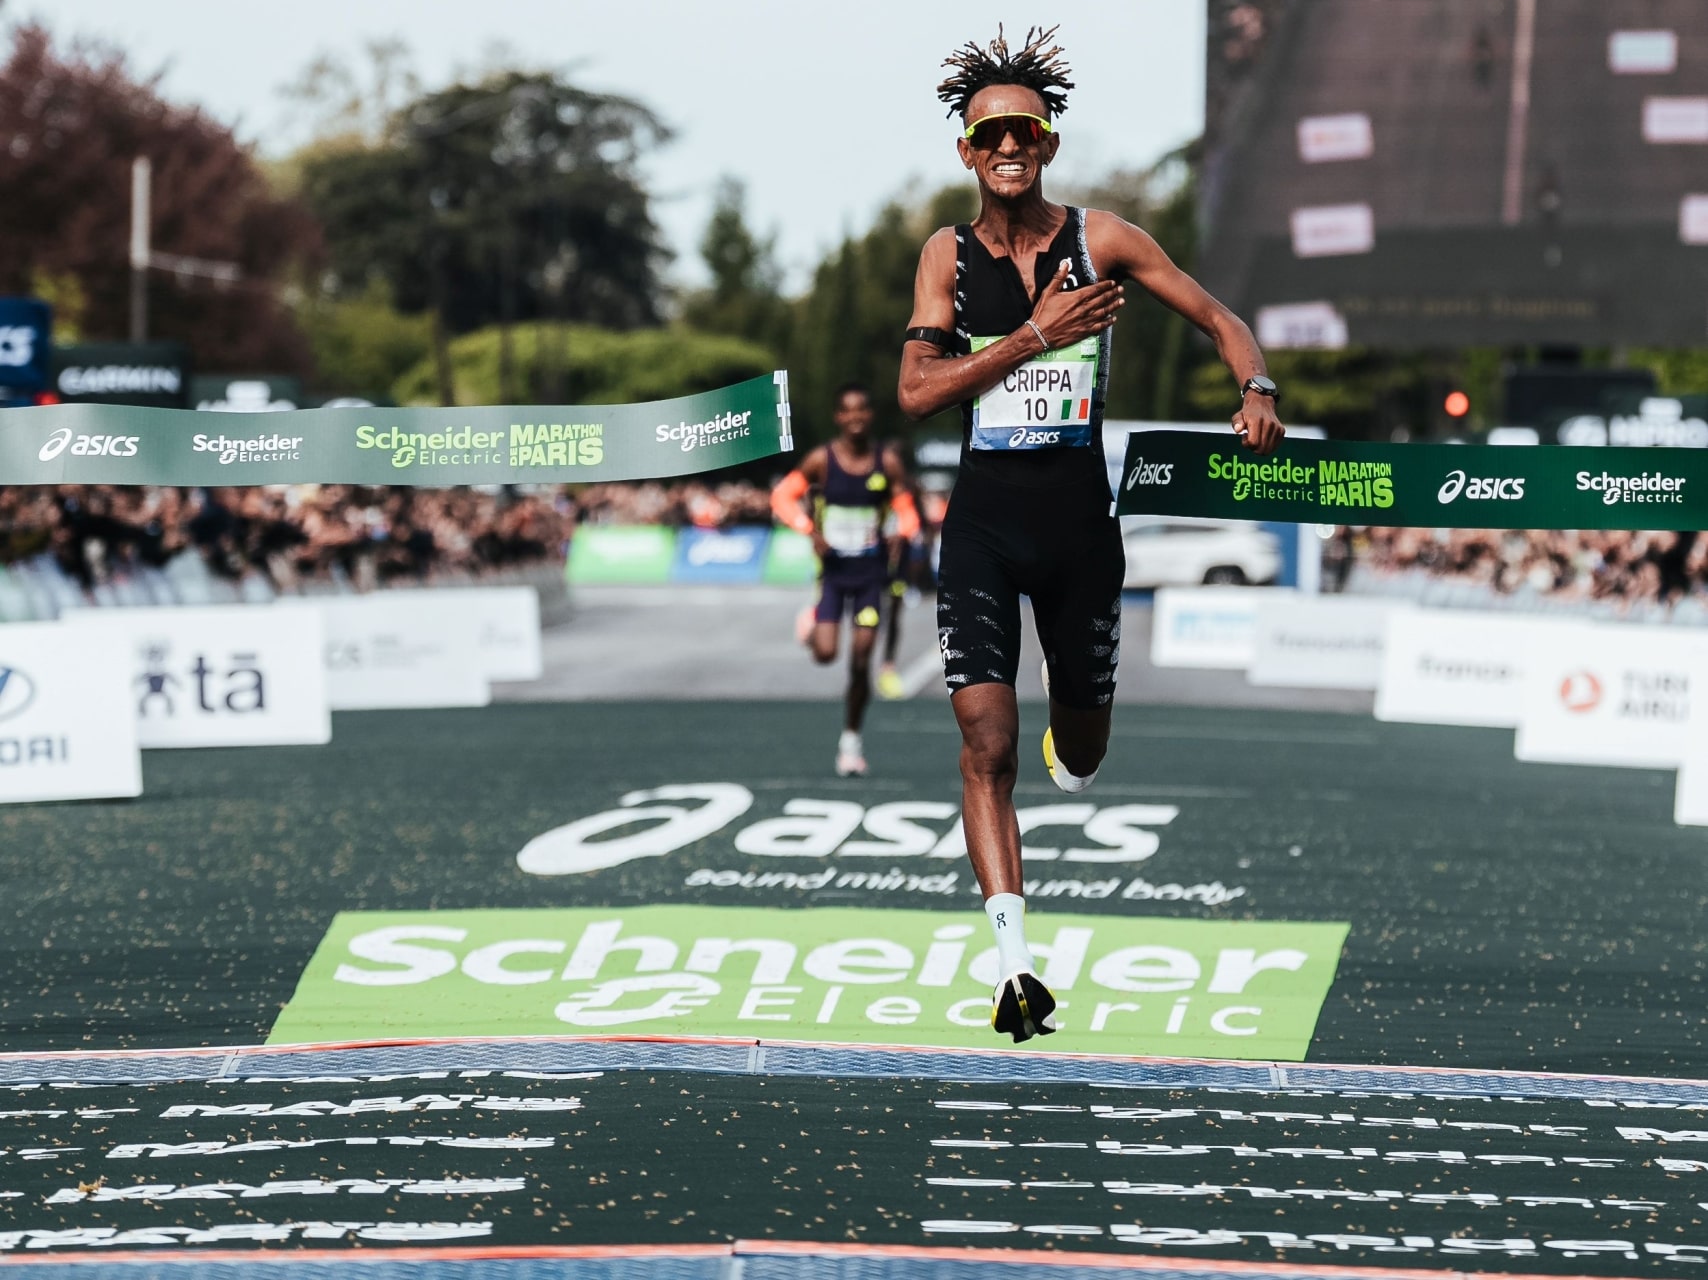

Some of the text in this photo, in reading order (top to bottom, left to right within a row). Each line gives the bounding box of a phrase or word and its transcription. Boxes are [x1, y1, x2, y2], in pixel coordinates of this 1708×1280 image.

[1003, 369, 1072, 393] CRIPPA
[1024, 397, 1048, 421] 10
[355, 425, 504, 451] Schneider
[510, 423, 603, 446] MARATHON
[655, 410, 751, 443] Schneider
[699, 425, 751, 447] Electric
[192, 433, 303, 456] Schneider
[519, 437, 603, 466] PARIS
[239, 450, 300, 463] Electric
[419, 450, 501, 465] Electric
[1208, 453, 1316, 485] Schneider
[1319, 459, 1392, 484] MARATHON
[1253, 483, 1314, 502] Electric
[1326, 477, 1394, 508] PARIS
[1576, 471, 1686, 493] Schneider
[1623, 491, 1684, 504] Electric
